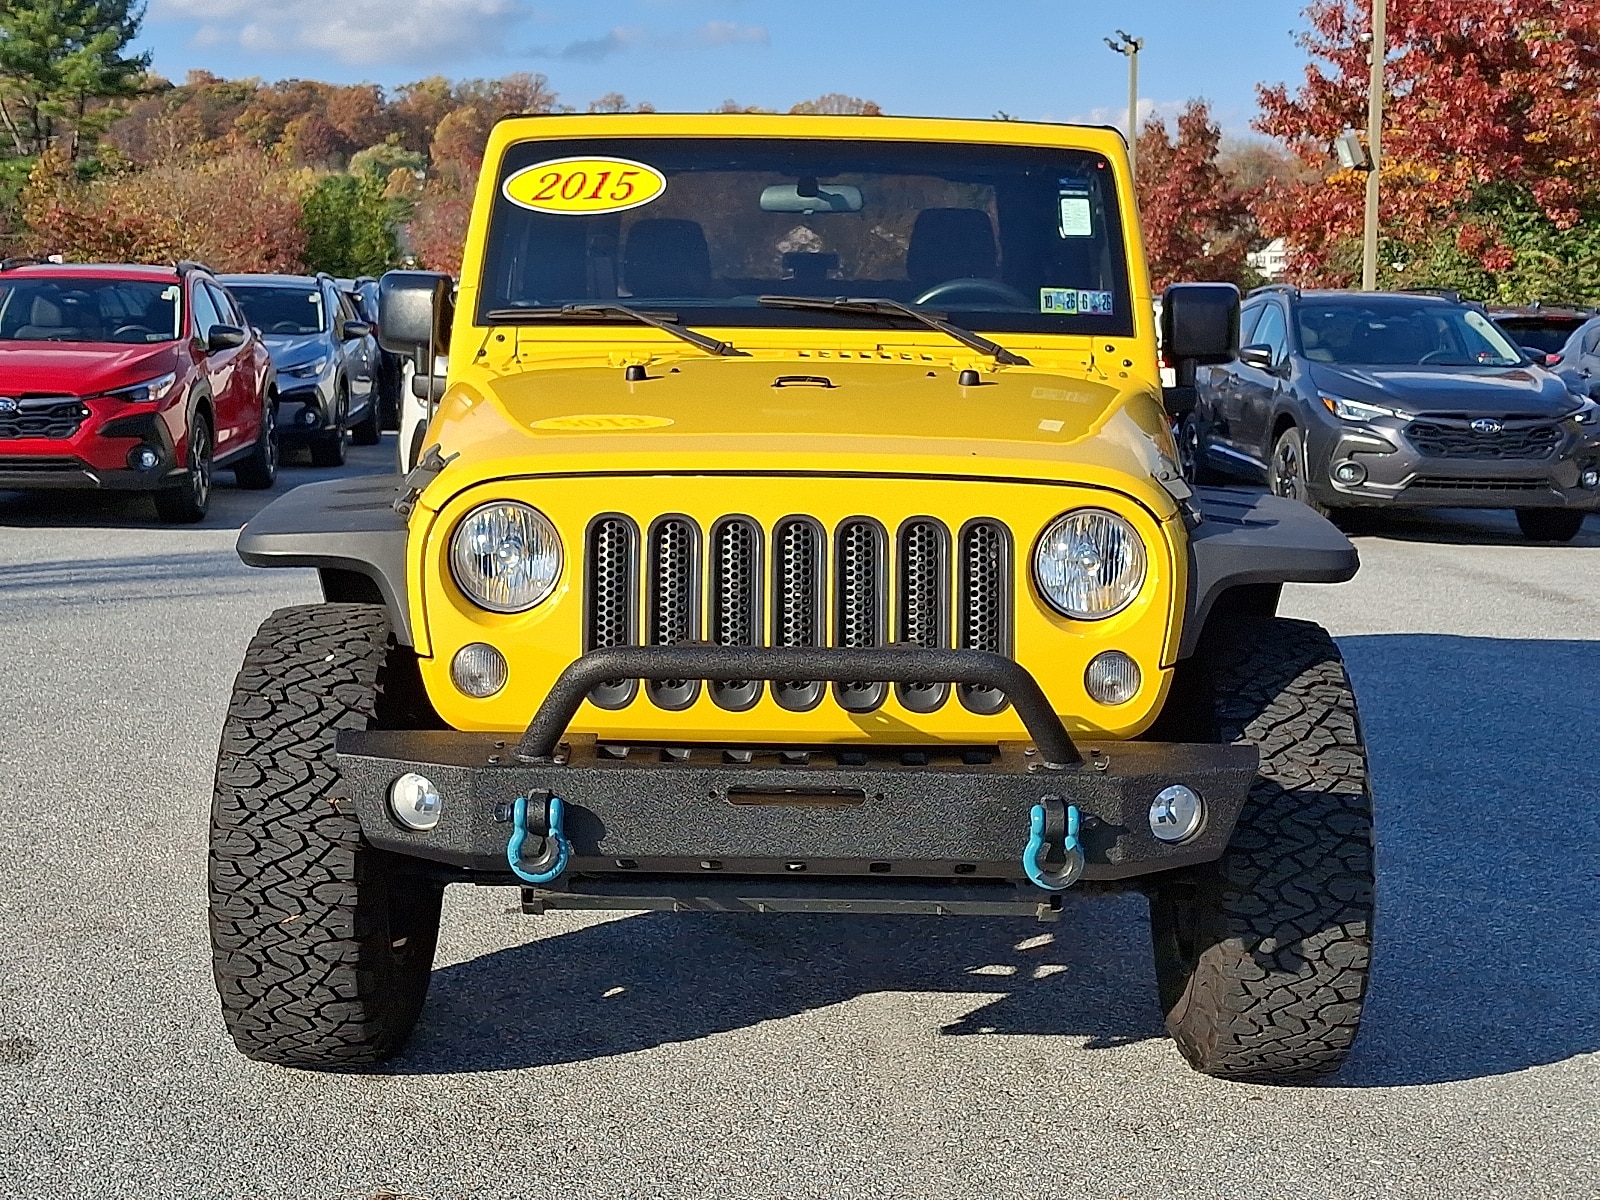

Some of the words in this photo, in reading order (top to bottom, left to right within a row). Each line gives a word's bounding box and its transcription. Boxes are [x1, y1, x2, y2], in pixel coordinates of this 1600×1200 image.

[531, 171, 640, 201] 2015
[1066, 292, 1075, 309] 26
[1082, 293, 1088, 310] 6
[1102, 294, 1111, 311] 26
